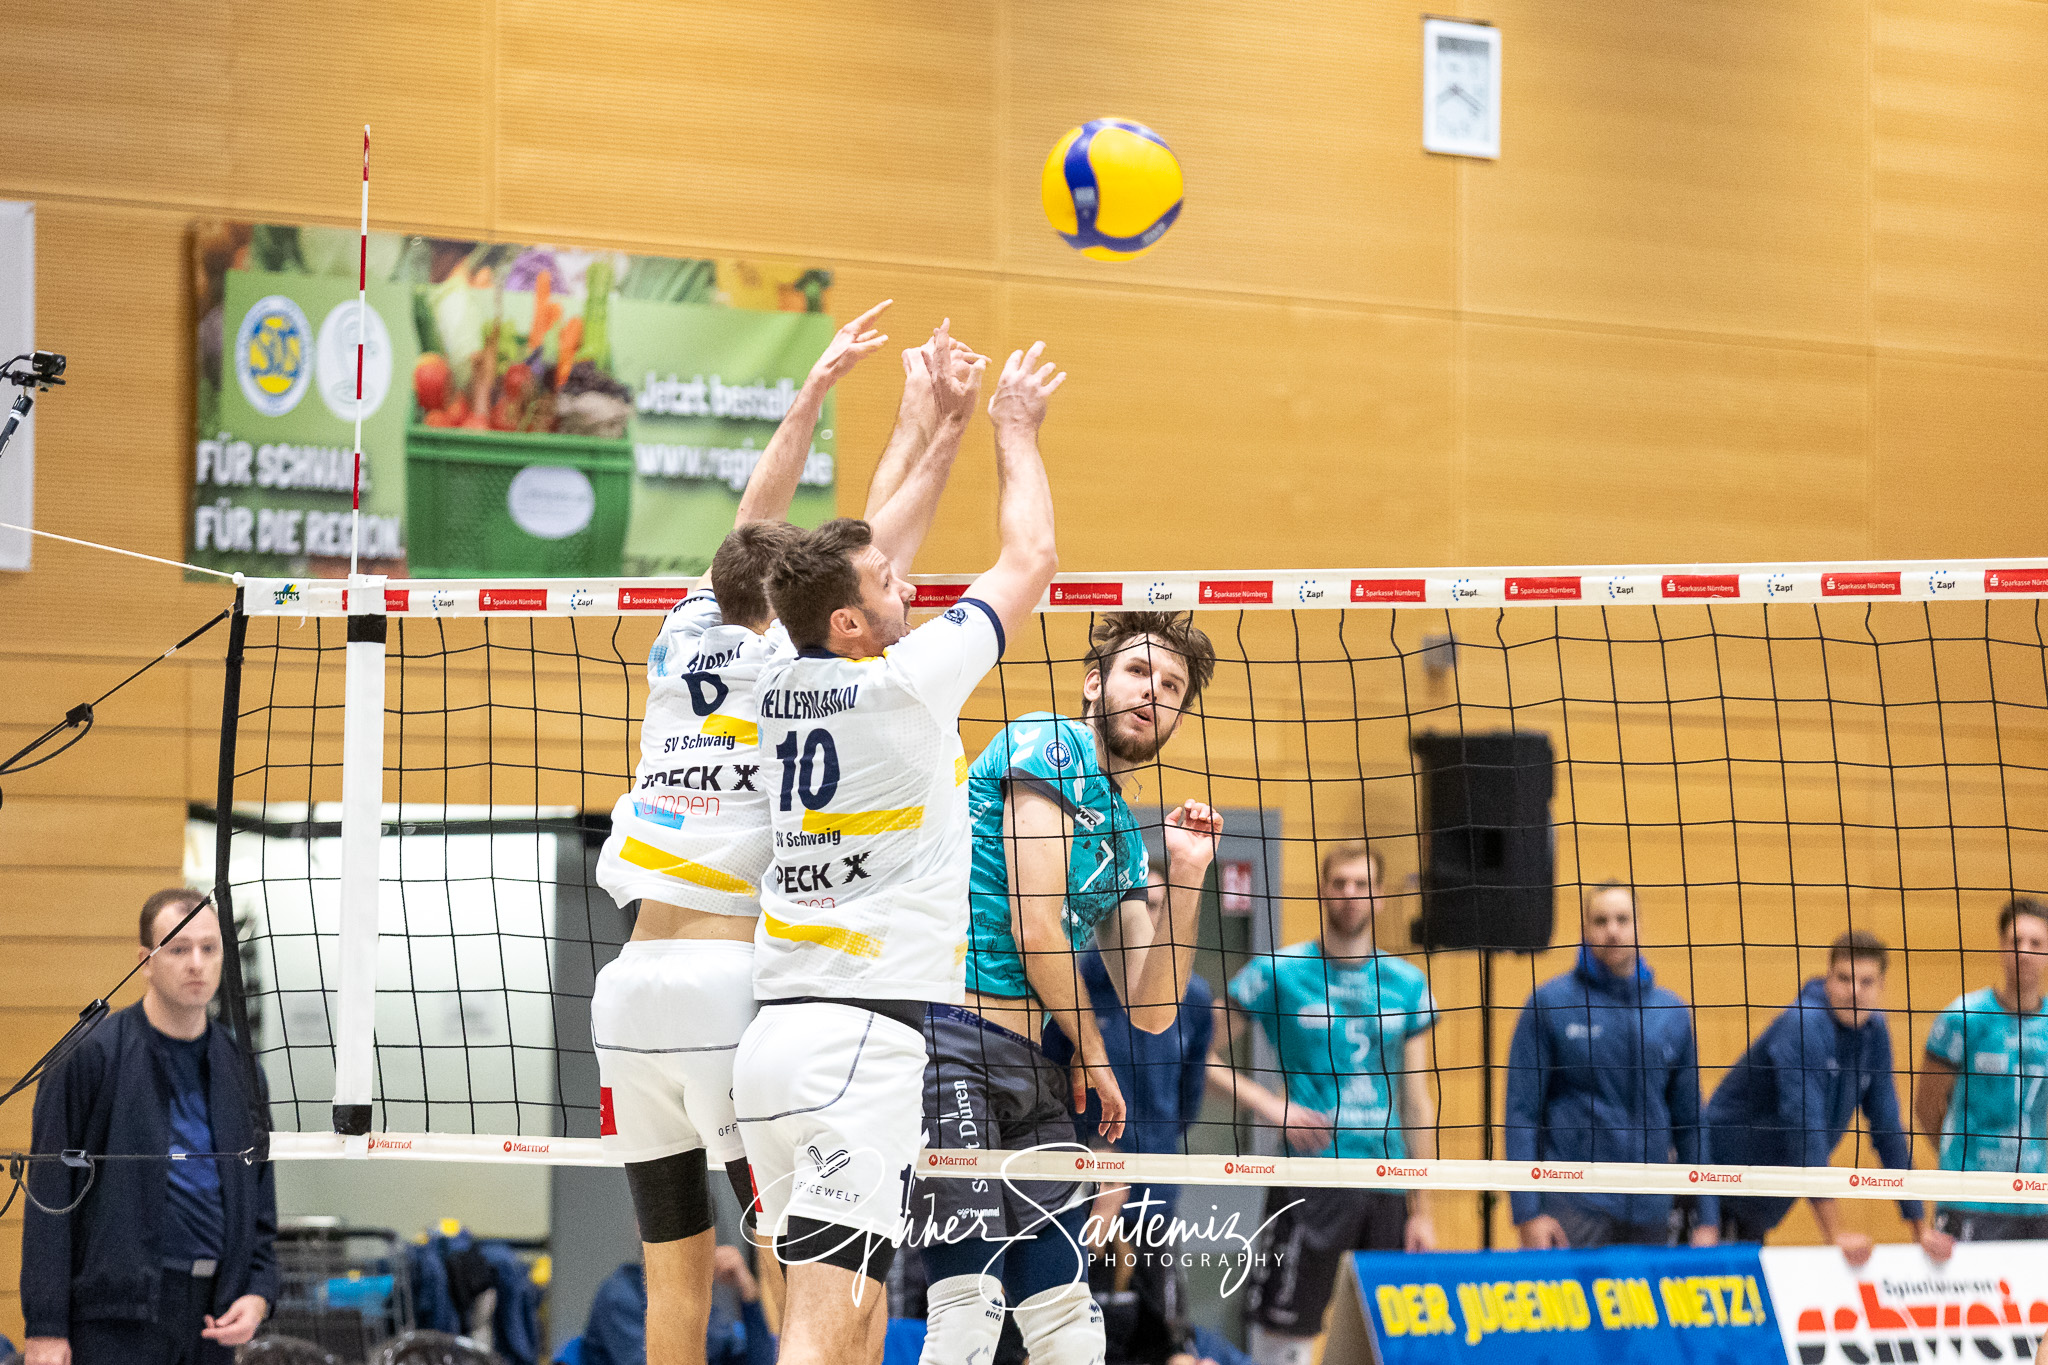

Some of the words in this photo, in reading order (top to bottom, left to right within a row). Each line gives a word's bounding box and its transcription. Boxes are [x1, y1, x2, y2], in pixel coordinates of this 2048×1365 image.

[196, 432, 253, 487] FÜR
[196, 497, 253, 552] FÜR
[1837, 582, 1867, 590] Sparkasse
[1867, 580, 1895, 591] Nürnberg
[1936, 580, 1956, 590] Zapf
[2000, 578, 2031, 587] Sparkasse
[1366, 589, 1393, 597] Sparkasse
[1394, 588, 1421, 597] Nürnberg
[1459, 588, 1477, 598] Zapf
[1520, 586, 1549, 595] Sparkasse
[1549, 585, 1576, 595] Nürnberg
[1616, 586, 1634, 595] Zapf
[1677, 584, 1706, 593] Sparkasse
[1707, 583, 1734, 593] Nürnberg
[1775, 583, 1793, 593] Zapf
[273, 592, 300, 602] HUCK
[918, 594, 944, 602] Sparkasse
[1065, 592, 1091, 601] Sparkasse
[1092, 591, 1117, 601] Nürnberg
[1155, 592, 1173, 601] Zapf
[1214, 590, 1241, 599] Sparkasse
[1242, 589, 1268, 599] Nürnberg
[1306, 590, 1324, 599] Zapf
[438, 599, 455, 607] Zapf
[492, 598, 518, 607] Sparkasse
[518, 597, 542, 607] Nürnberg
[577, 598, 594, 607] Zapf
[632, 597, 657, 606] Sparkasse
[658, 596, 681, 605] Nürnber
[664, 737, 679, 754] SV
[681, 731, 736, 750] Schwaig
[776, 728, 840, 811] 10
[786, 827, 841, 848] Schwaig
[774, 862, 833, 893] PECK
[376, 1139, 412, 1149] Marmot
[513, 1142, 550, 1153] Marmot
[939, 1156, 978, 1166] Marmot
[1085, 1159, 1126, 1170] Marmot
[1235, 1163, 1275, 1174] Marmot
[1387, 1166, 1428, 1177] Marmot
[1542, 1169, 1584, 1180] Marmot
[1700, 1172, 1743, 1183] Marmot
[1861, 1176, 1904, 1187] Marmot
[2025, 1181, 2048, 1191] Mar
[1375, 1283, 1456, 1337] DER
[1456, 1279, 1591, 1346] JUGEND
[1592, 1277, 1659, 1330] EIN
[1659, 1274, 1766, 1329] NETZ!
